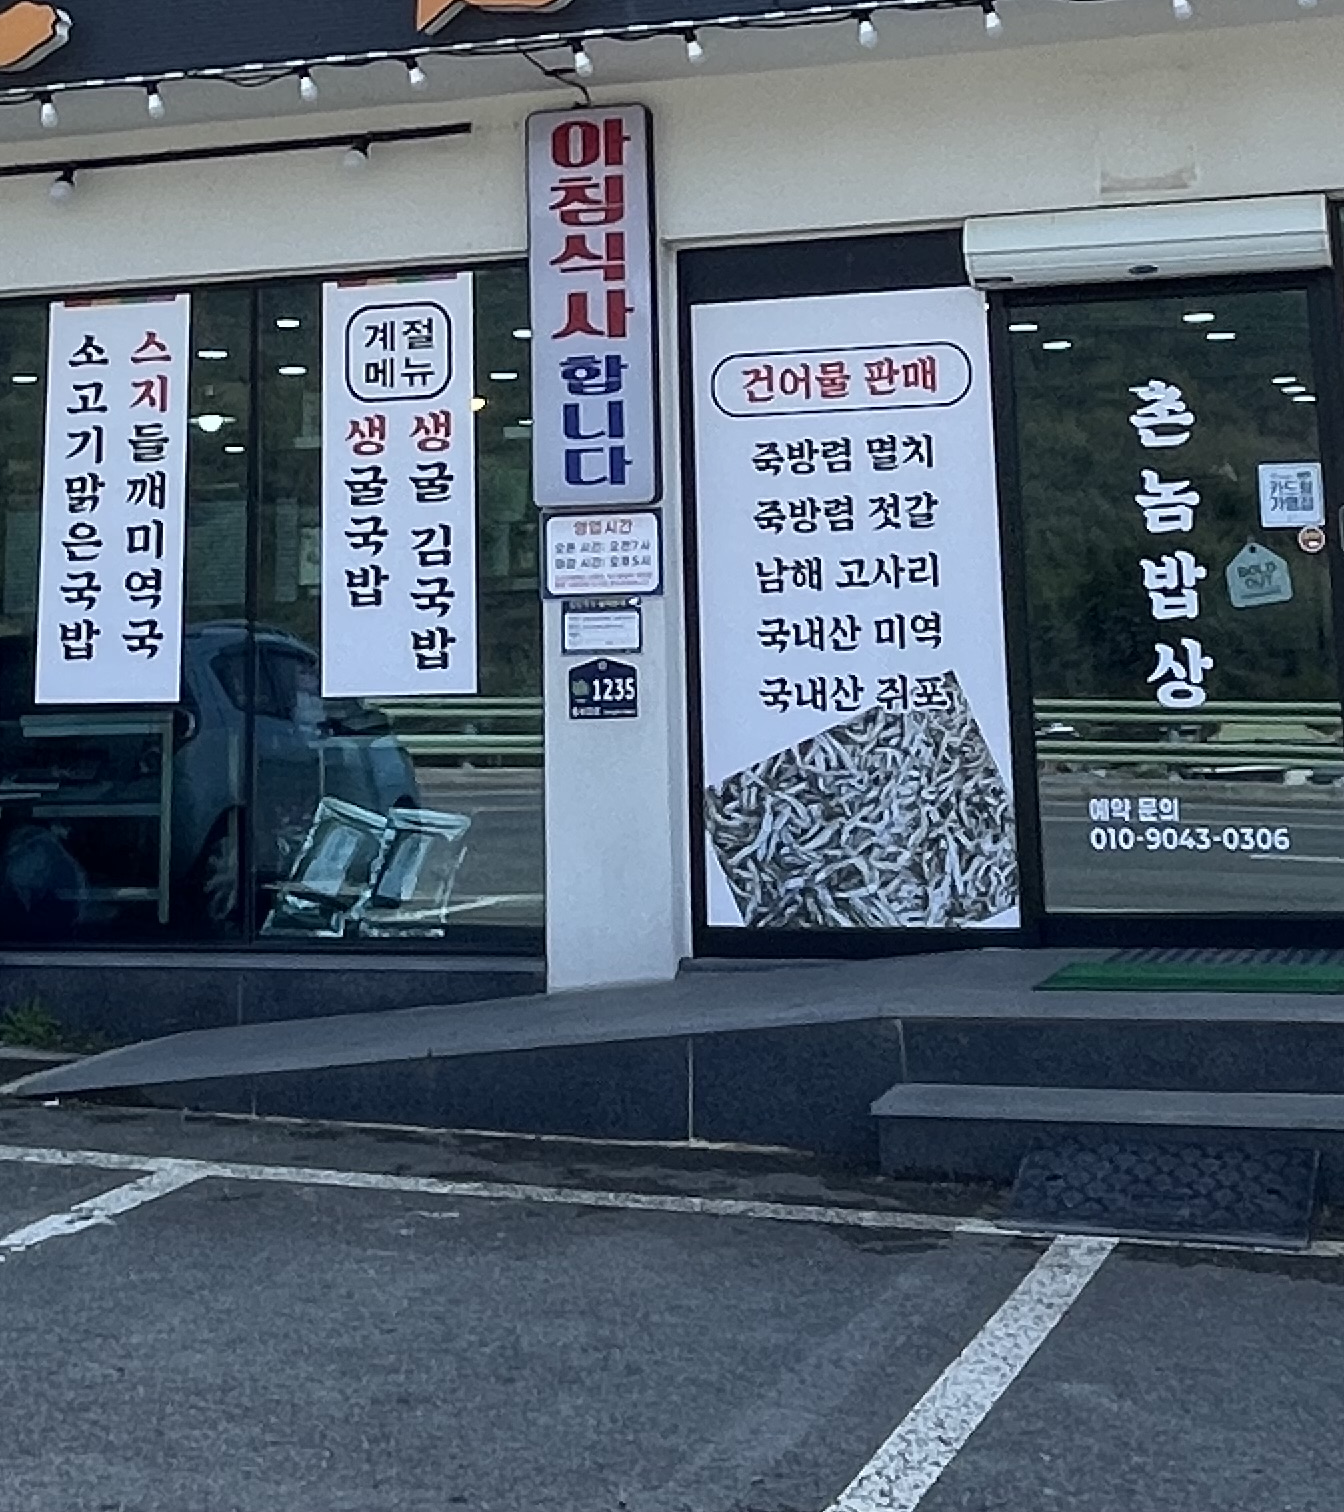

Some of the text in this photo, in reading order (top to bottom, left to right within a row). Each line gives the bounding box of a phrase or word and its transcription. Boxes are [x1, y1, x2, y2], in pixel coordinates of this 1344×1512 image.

[364, 317, 435, 352] 계절
[364, 356, 436, 388] 메뉴
[741, 355, 938, 402] 건어물 판매
[752, 433, 934, 476] 죽방렴 멸치
[59, 334, 109, 662] 소고기맑은국밥
[122, 332, 172, 658] 스지들깨미역국
[345, 414, 388, 609] 생굴국밥
[753, 491, 939, 534] 죽방렴 젓갈
[1129, 378, 1214, 709] 촌놈밥상
[755, 551, 939, 593] 남해 고사리
[757, 611, 941, 653] 국내산 미역
[592, 677, 636, 700] 1235
[759, 673, 948, 713] 국내산 쥐포
[1088, 798, 1180, 822] 예약 문의
[1090, 828, 1290, 851] 010-9043-0306
